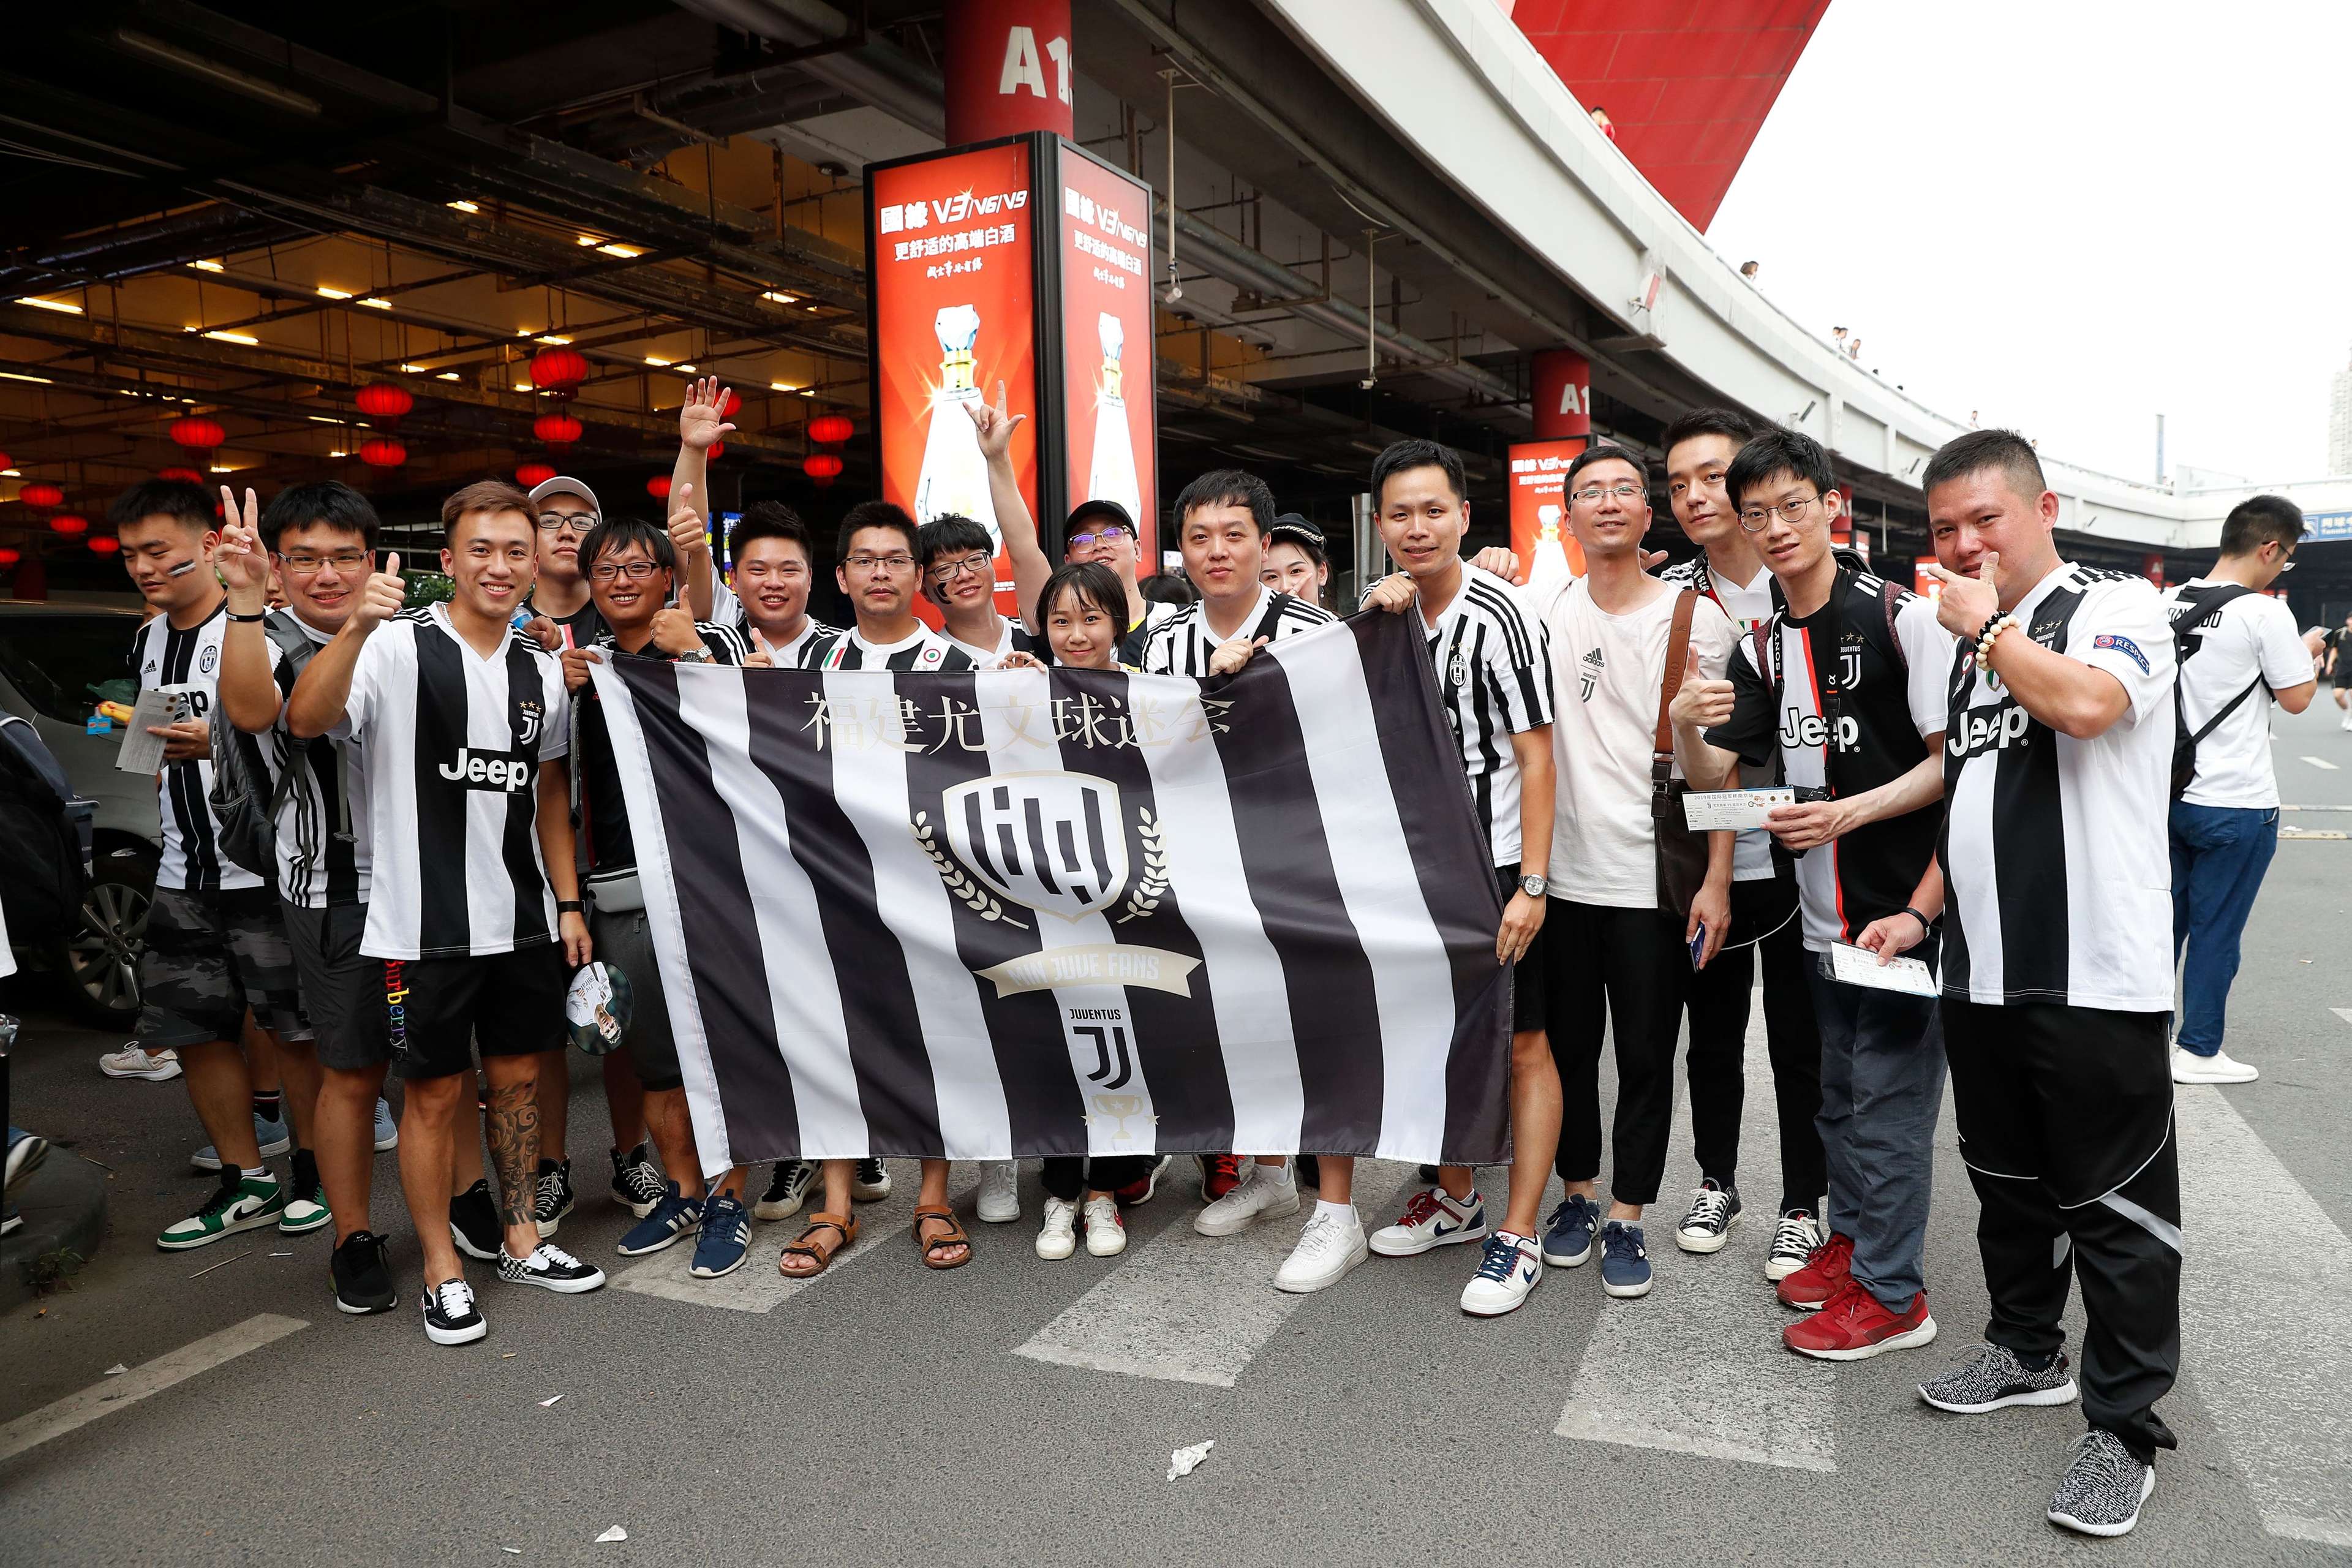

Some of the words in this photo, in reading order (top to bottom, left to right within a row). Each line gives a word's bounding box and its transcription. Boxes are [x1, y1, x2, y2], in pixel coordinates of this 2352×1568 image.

[1000, 26, 1073, 110] A1
[894, 224, 1015, 261] 更舒适的高端白酒
[1583, 656, 1605, 668] adidas
[2116, 639, 2149, 671] RESPECT
[799, 691, 1235, 755] 福建尤文球迷会
[1948, 706, 2029, 757] Jeep
[439, 748, 529, 792] Jeep
[1006, 960, 1049, 987] MIN
[1107, 953, 1159, 980] FANS
[1069, 1009, 1121, 1020] JUVENTUS
